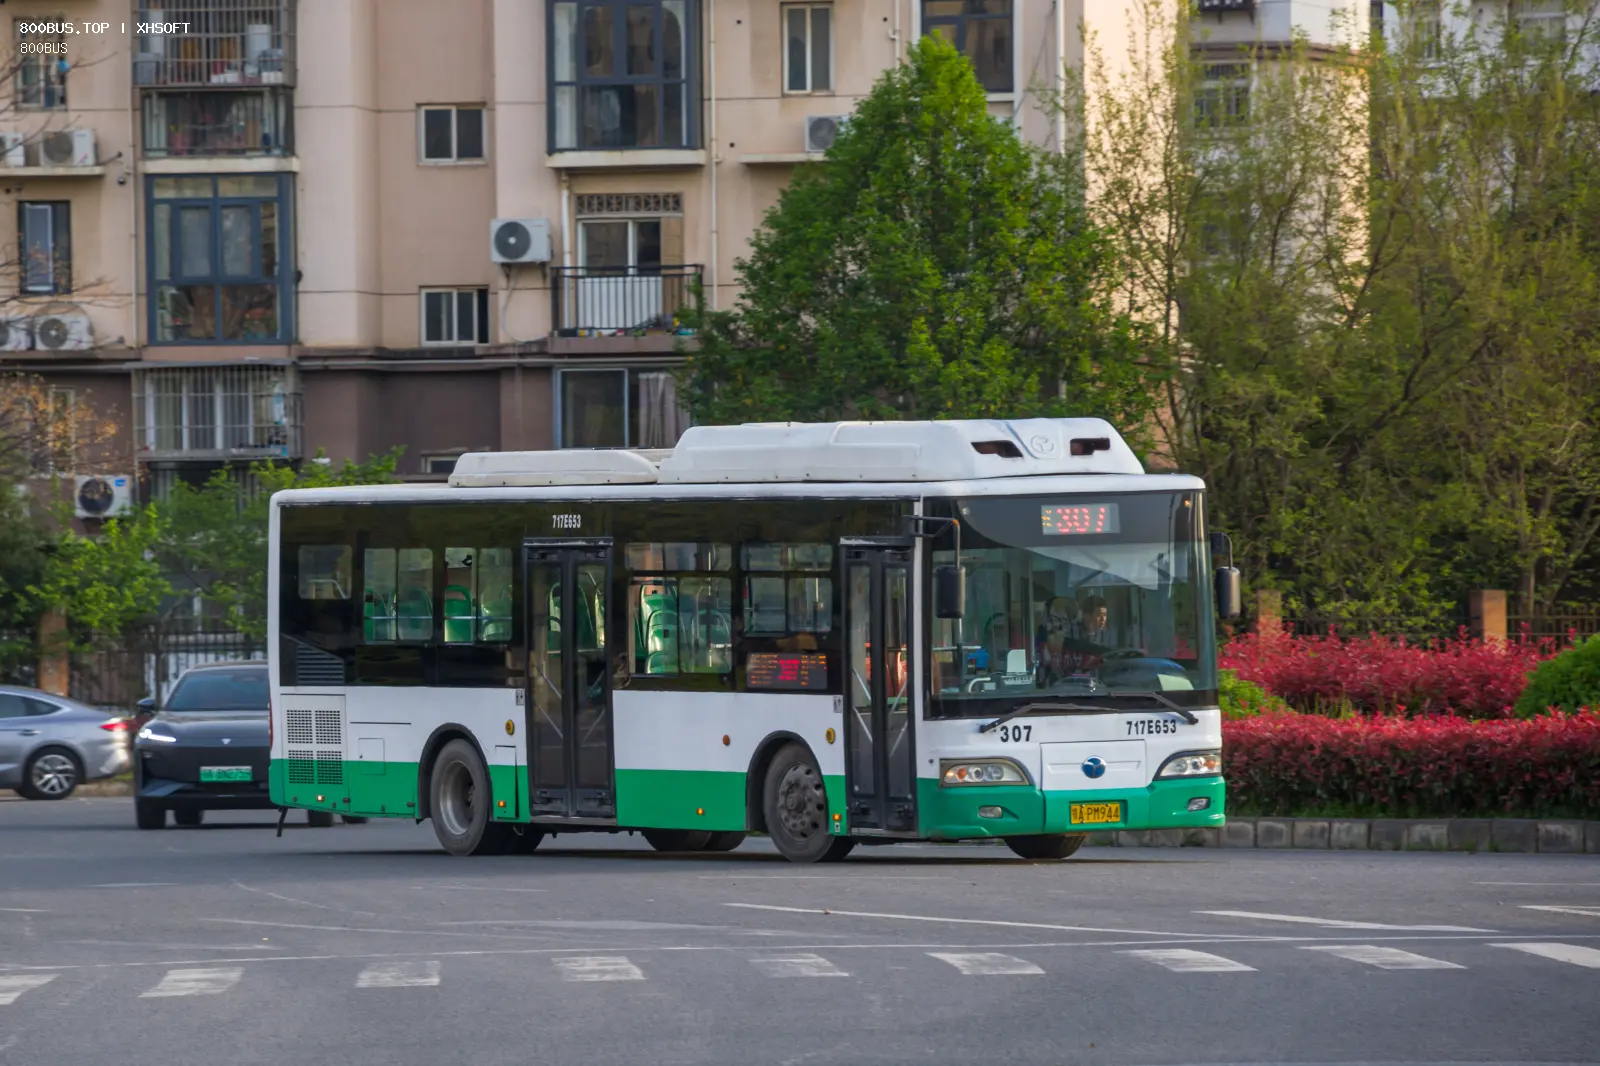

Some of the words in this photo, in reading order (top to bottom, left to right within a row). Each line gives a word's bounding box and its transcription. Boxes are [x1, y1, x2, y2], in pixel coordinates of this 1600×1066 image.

[552, 514, 582, 529] 717E653
[1000, 725, 1032, 743] 307
[1126, 719, 1177, 736] 717E653
